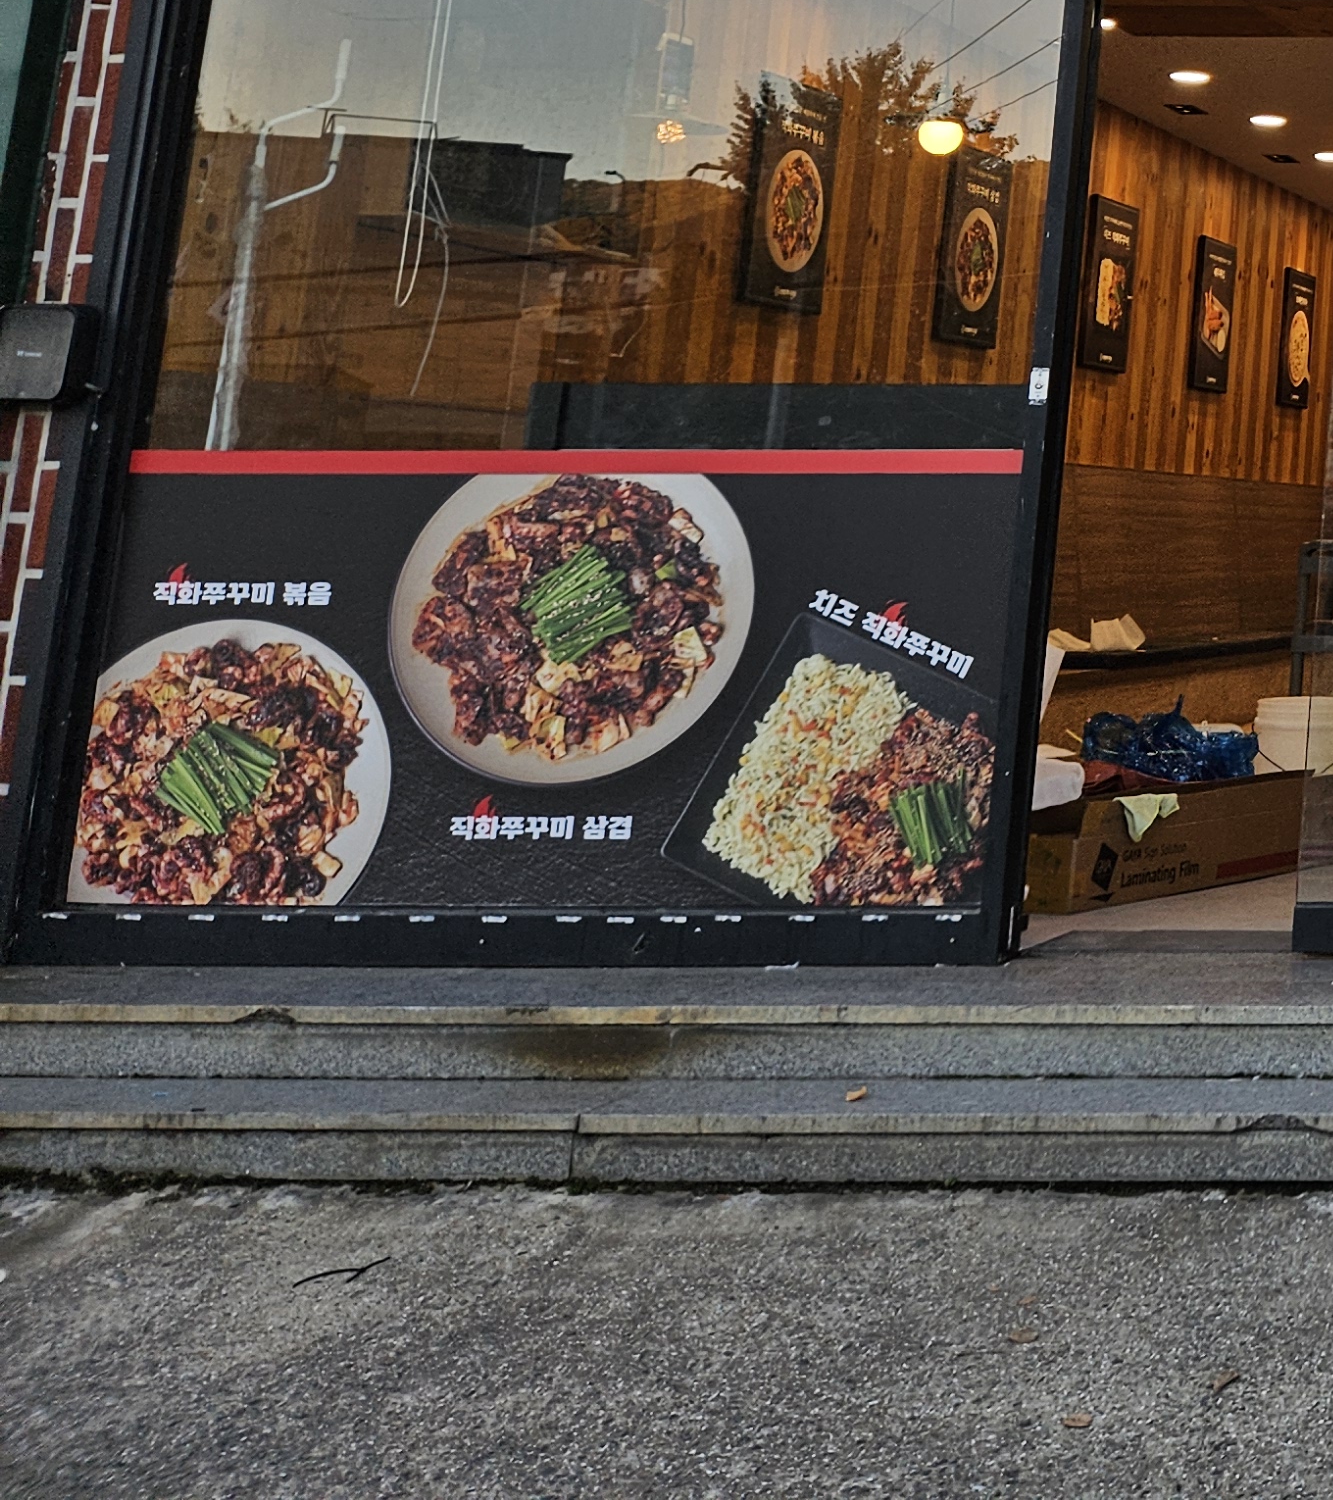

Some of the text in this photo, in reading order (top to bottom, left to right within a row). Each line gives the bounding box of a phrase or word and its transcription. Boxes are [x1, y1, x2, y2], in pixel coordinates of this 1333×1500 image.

[153, 579, 333, 608] 직화쭈꾸미 볶음
[809, 586, 976, 680] 치즈 직화쭈꾸미
[449, 813, 634, 842] 직화쭈꾸미 삼겹
[1120, 859, 1200, 889] Laminating Film
